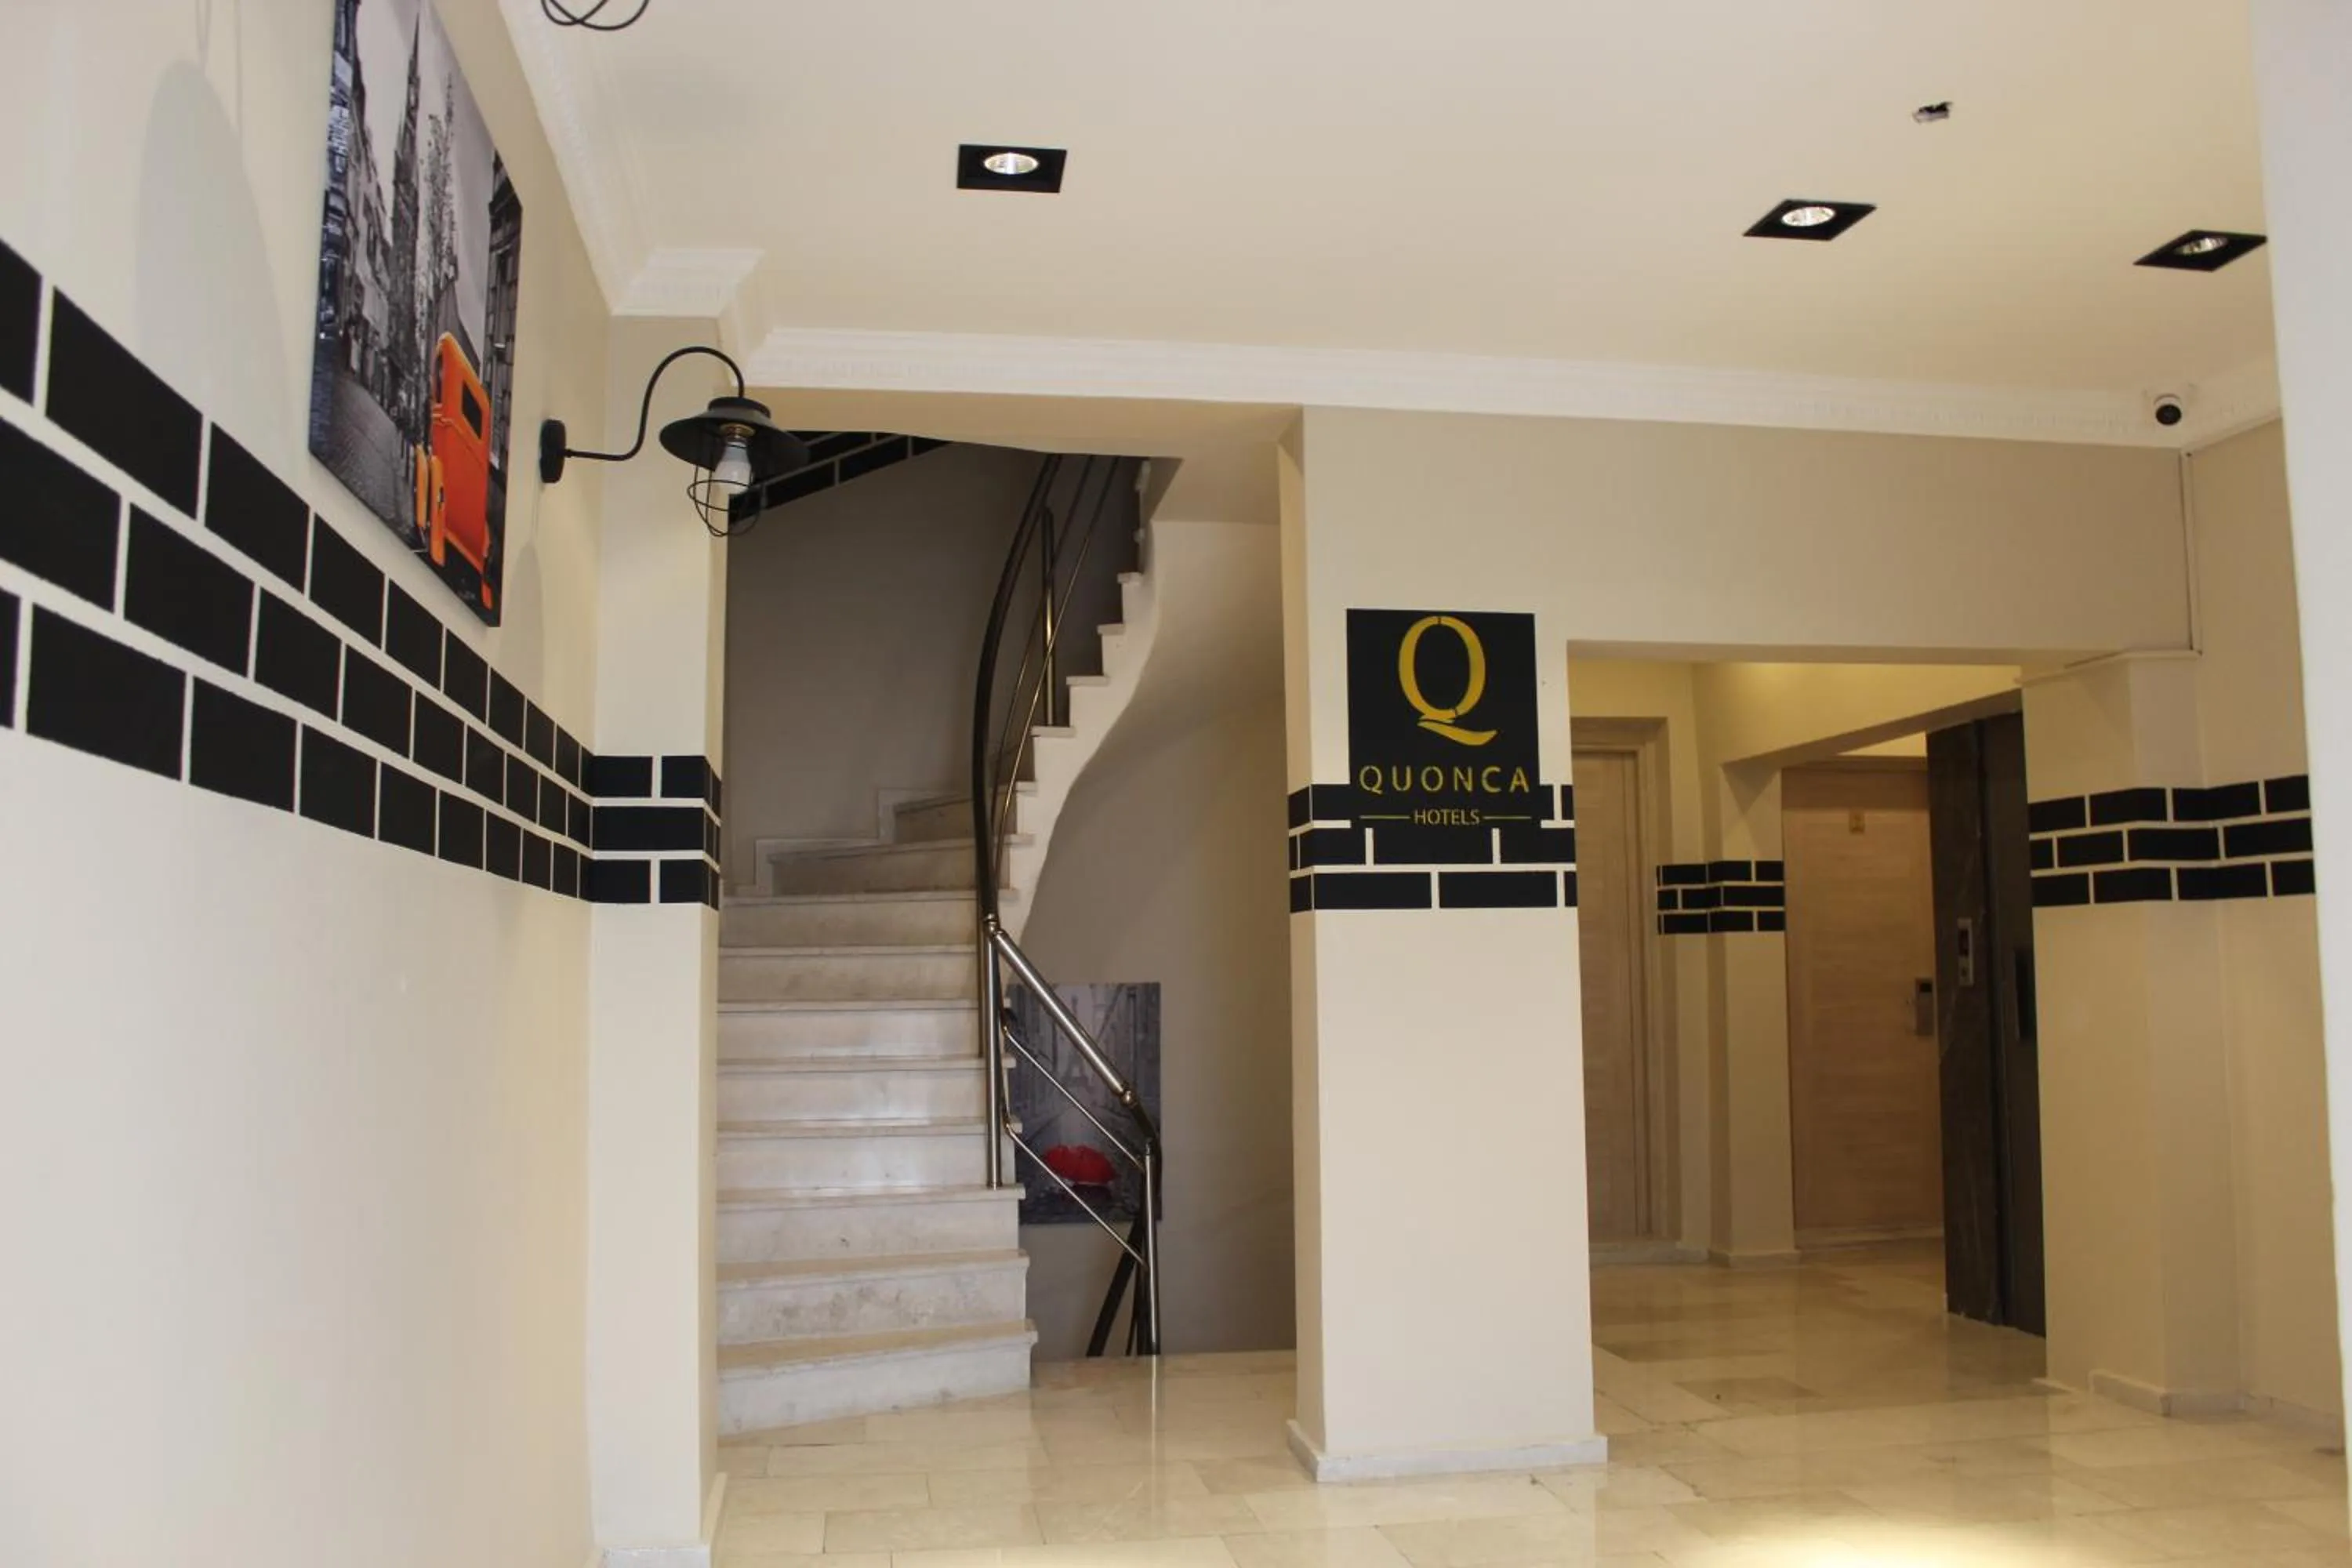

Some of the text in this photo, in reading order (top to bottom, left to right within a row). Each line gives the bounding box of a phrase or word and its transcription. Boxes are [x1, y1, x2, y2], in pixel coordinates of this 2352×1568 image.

[1398, 615, 1497, 746] Q
[1359, 765, 1529, 794] QUONCA
[1414, 809, 1480, 826] HOTELS
